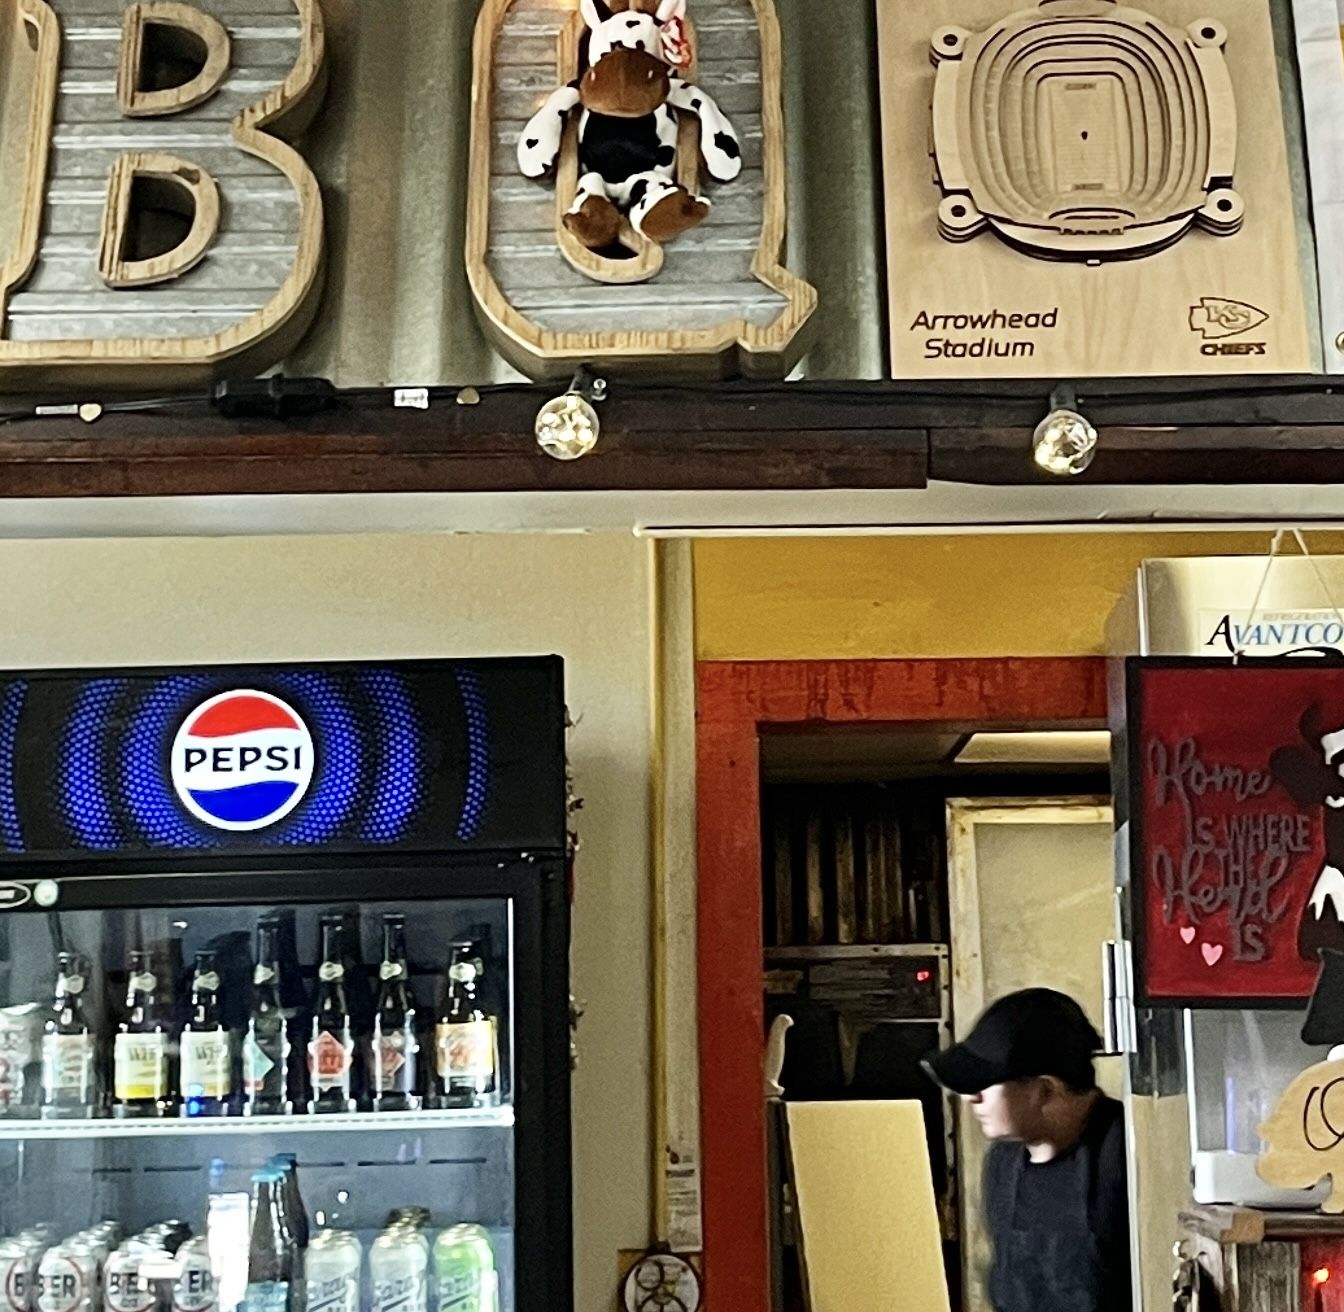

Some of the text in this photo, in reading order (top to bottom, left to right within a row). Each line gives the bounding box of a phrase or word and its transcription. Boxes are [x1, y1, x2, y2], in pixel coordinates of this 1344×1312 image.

[910, 306, 1058, 332] Arrowhead
[924, 337, 1035, 359] Stadium
[1200, 342, 1267, 356] CHIEFS
[183, 746, 303, 774] PEPSI
[1148, 737, 1271, 808] Home
